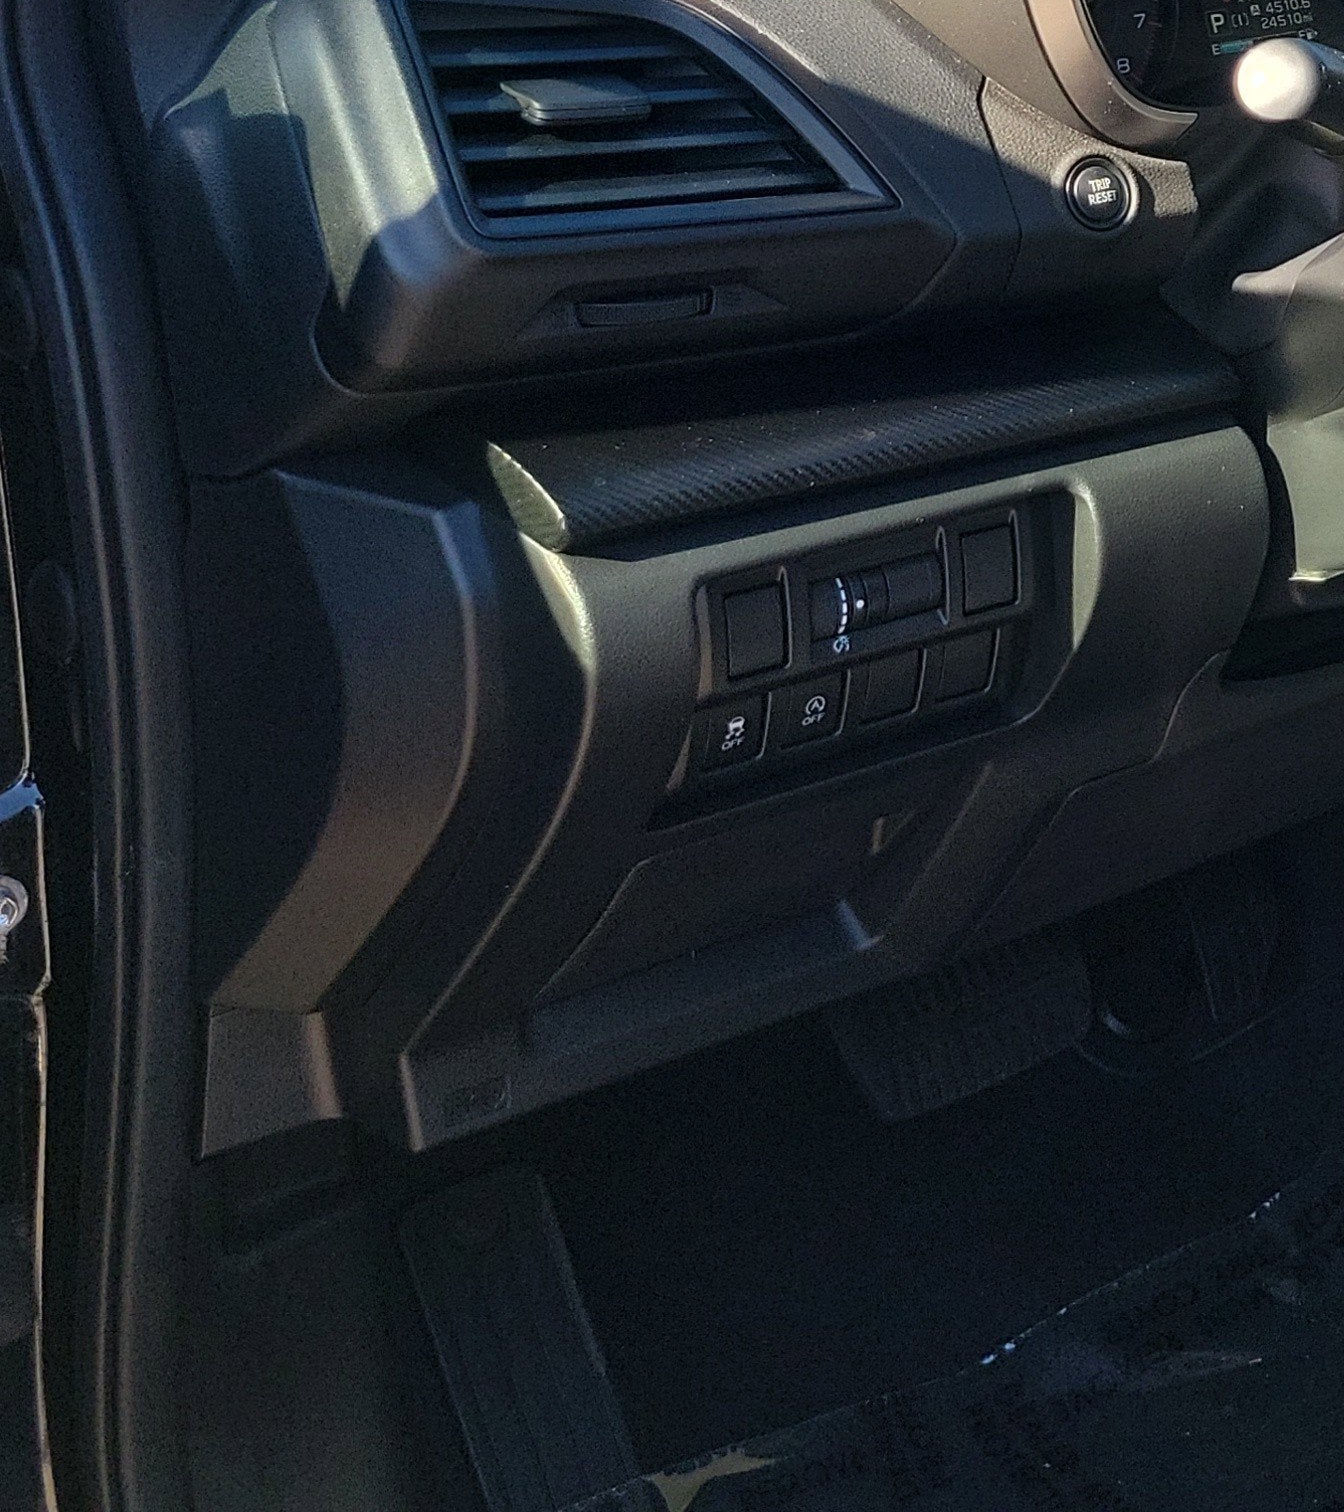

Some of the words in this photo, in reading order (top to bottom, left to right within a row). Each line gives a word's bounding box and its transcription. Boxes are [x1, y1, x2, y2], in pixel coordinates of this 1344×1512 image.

[1132, 13, 1147, 29] 7
[1210, 13, 1226, 34] P
[1116, 57, 1131, 74] 8
[1088, 177, 1111, 193] TRIP
[1087, 190, 1117, 206] RESET
[802, 712, 826, 727] OFF
[721, 737, 745, 752] OFF
